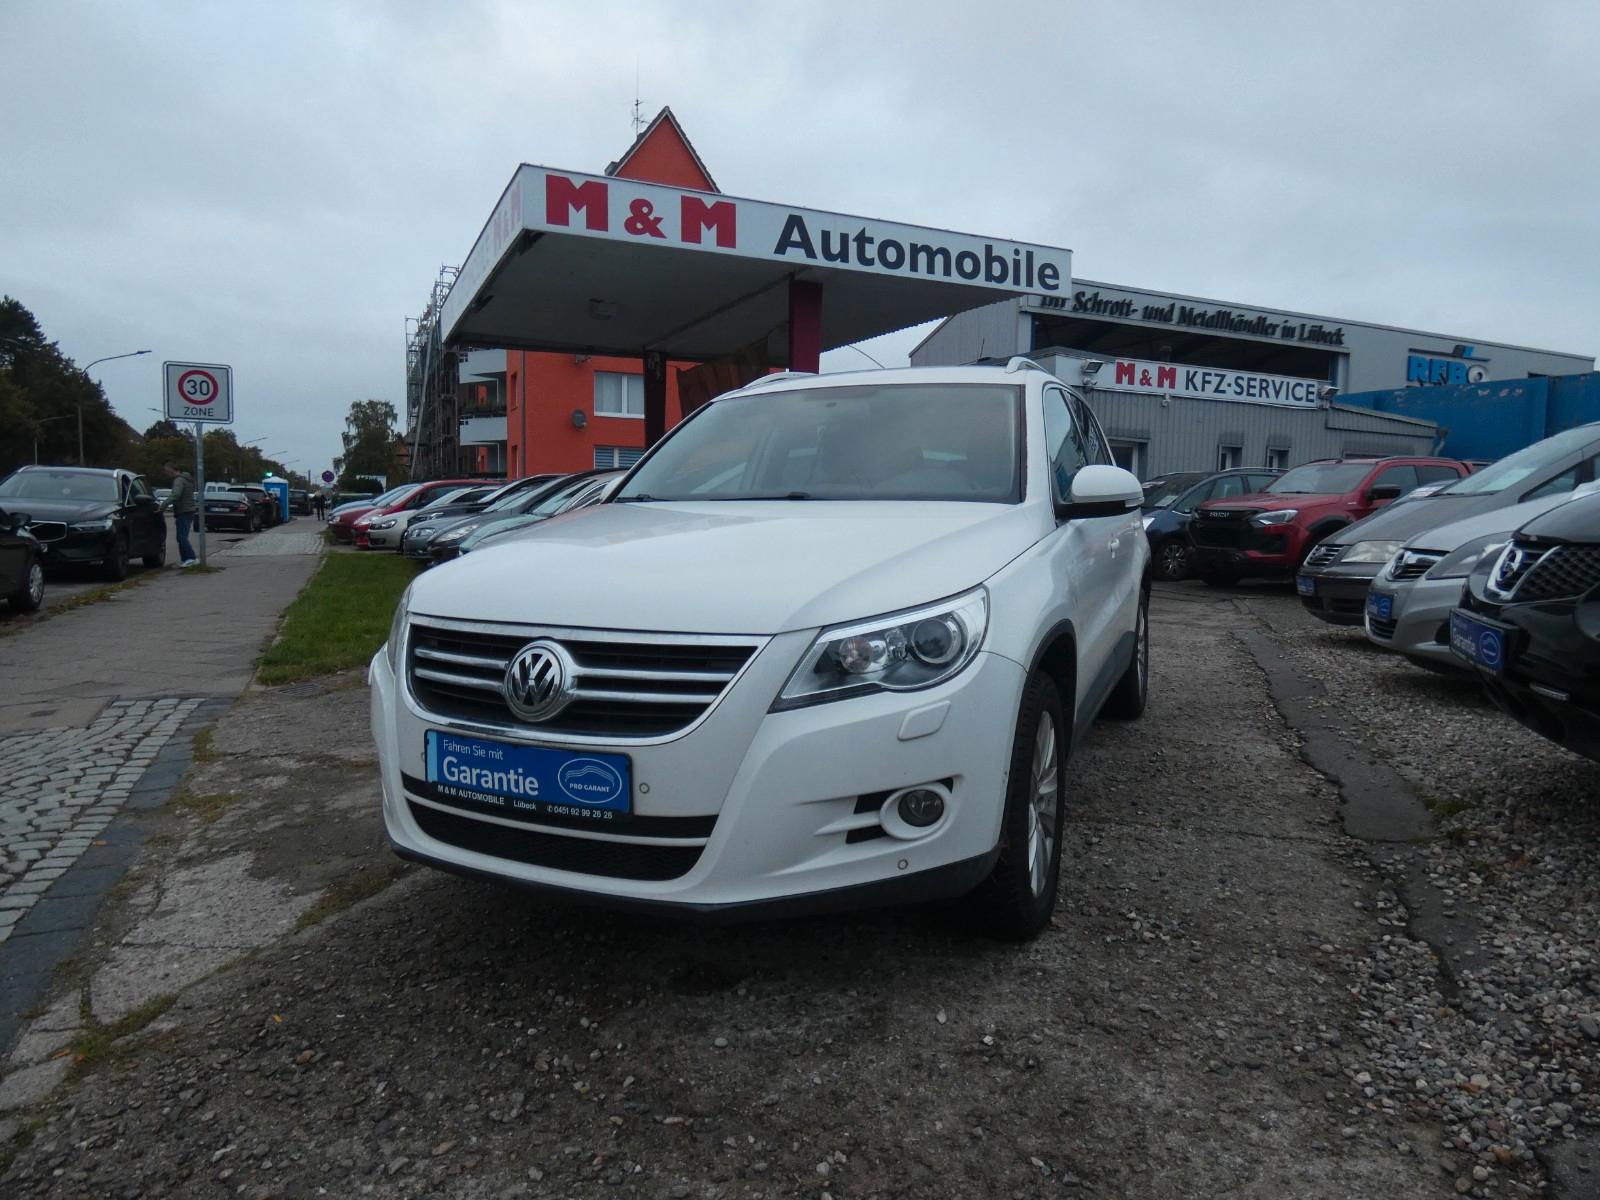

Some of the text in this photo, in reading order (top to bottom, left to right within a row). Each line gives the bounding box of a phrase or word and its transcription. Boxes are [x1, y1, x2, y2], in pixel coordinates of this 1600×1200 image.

[546, 174, 1060, 291] M & M Automobile
[1072, 291, 1139, 317] Schrott-
[1142, 302, 1176, 322] und
[1176, 305, 1281, 337] Metallhändler
[1281, 319, 1298, 339] in
[1298, 323, 1345, 346] Lübeck
[187, 379, 210, 396] 30
[1115, 361, 1136, 386] M
[1139, 368, 1153, 387] &
[1157, 366, 1177, 390] M
[184, 406, 214, 417] ZONE
[443, 739, 504, 760] Fahren Sie mit
[443, 755, 539, 796] Garantie
[583, 784, 610, 793] GARANT
[437, 784, 444, 792] M
[444, 786, 450, 794] &
[450, 787, 457, 796] M
[458, 789, 505, 806] AUTOMOBILE
[513, 800, 537, 810] Lübeck
[553, 806, 569, 815] 0451
[570, 808, 580, 816] 92
